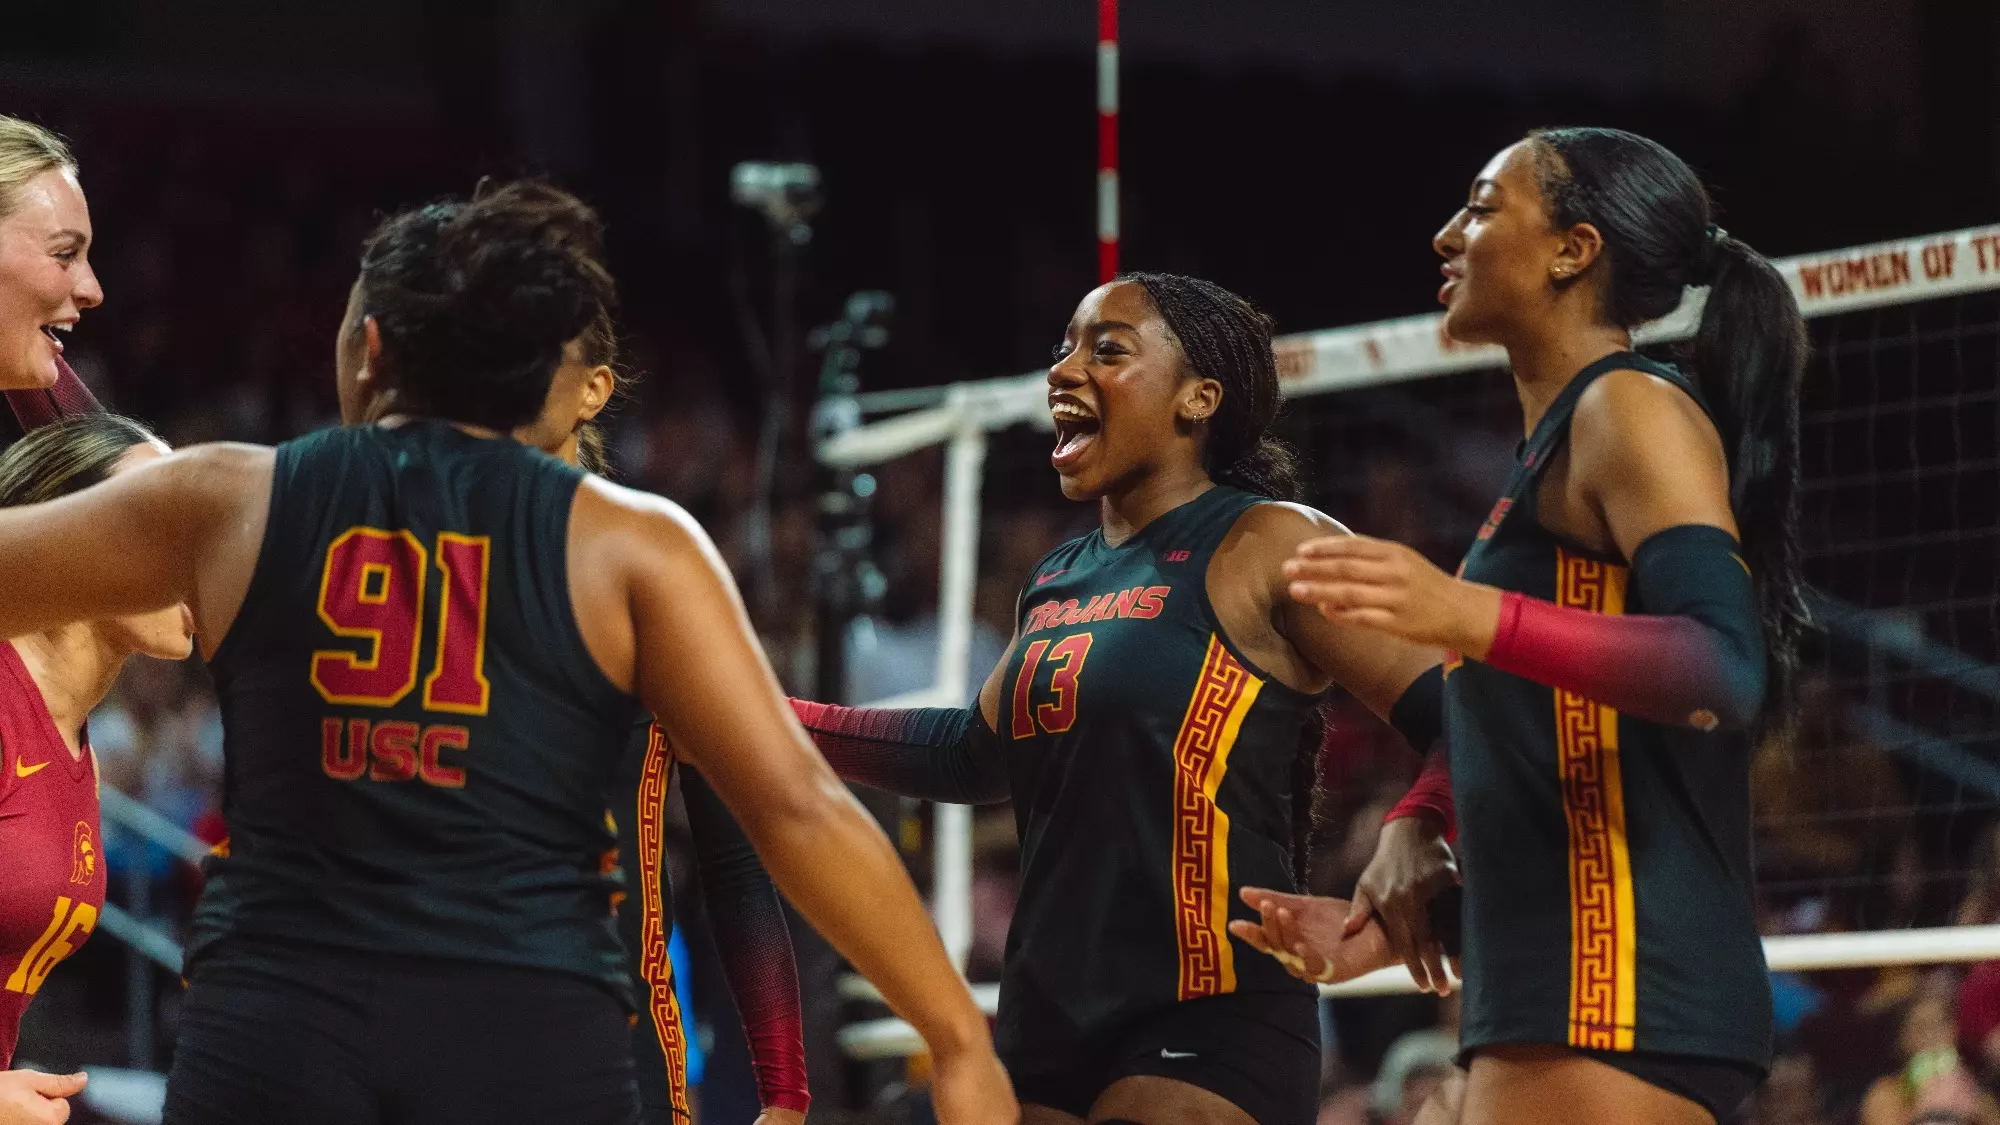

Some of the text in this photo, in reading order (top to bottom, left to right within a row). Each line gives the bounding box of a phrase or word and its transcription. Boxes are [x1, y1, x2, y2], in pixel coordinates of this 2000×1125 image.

[1798, 251, 1911, 297] WOMEN
[1921, 243, 1956, 280] OF
[310, 526, 490, 715] 91
[1020, 586, 1171, 639] TROJANS
[1012, 632, 1093, 739] 13
[322, 717, 469, 787] USC
[4, 896, 97, 995] 16
